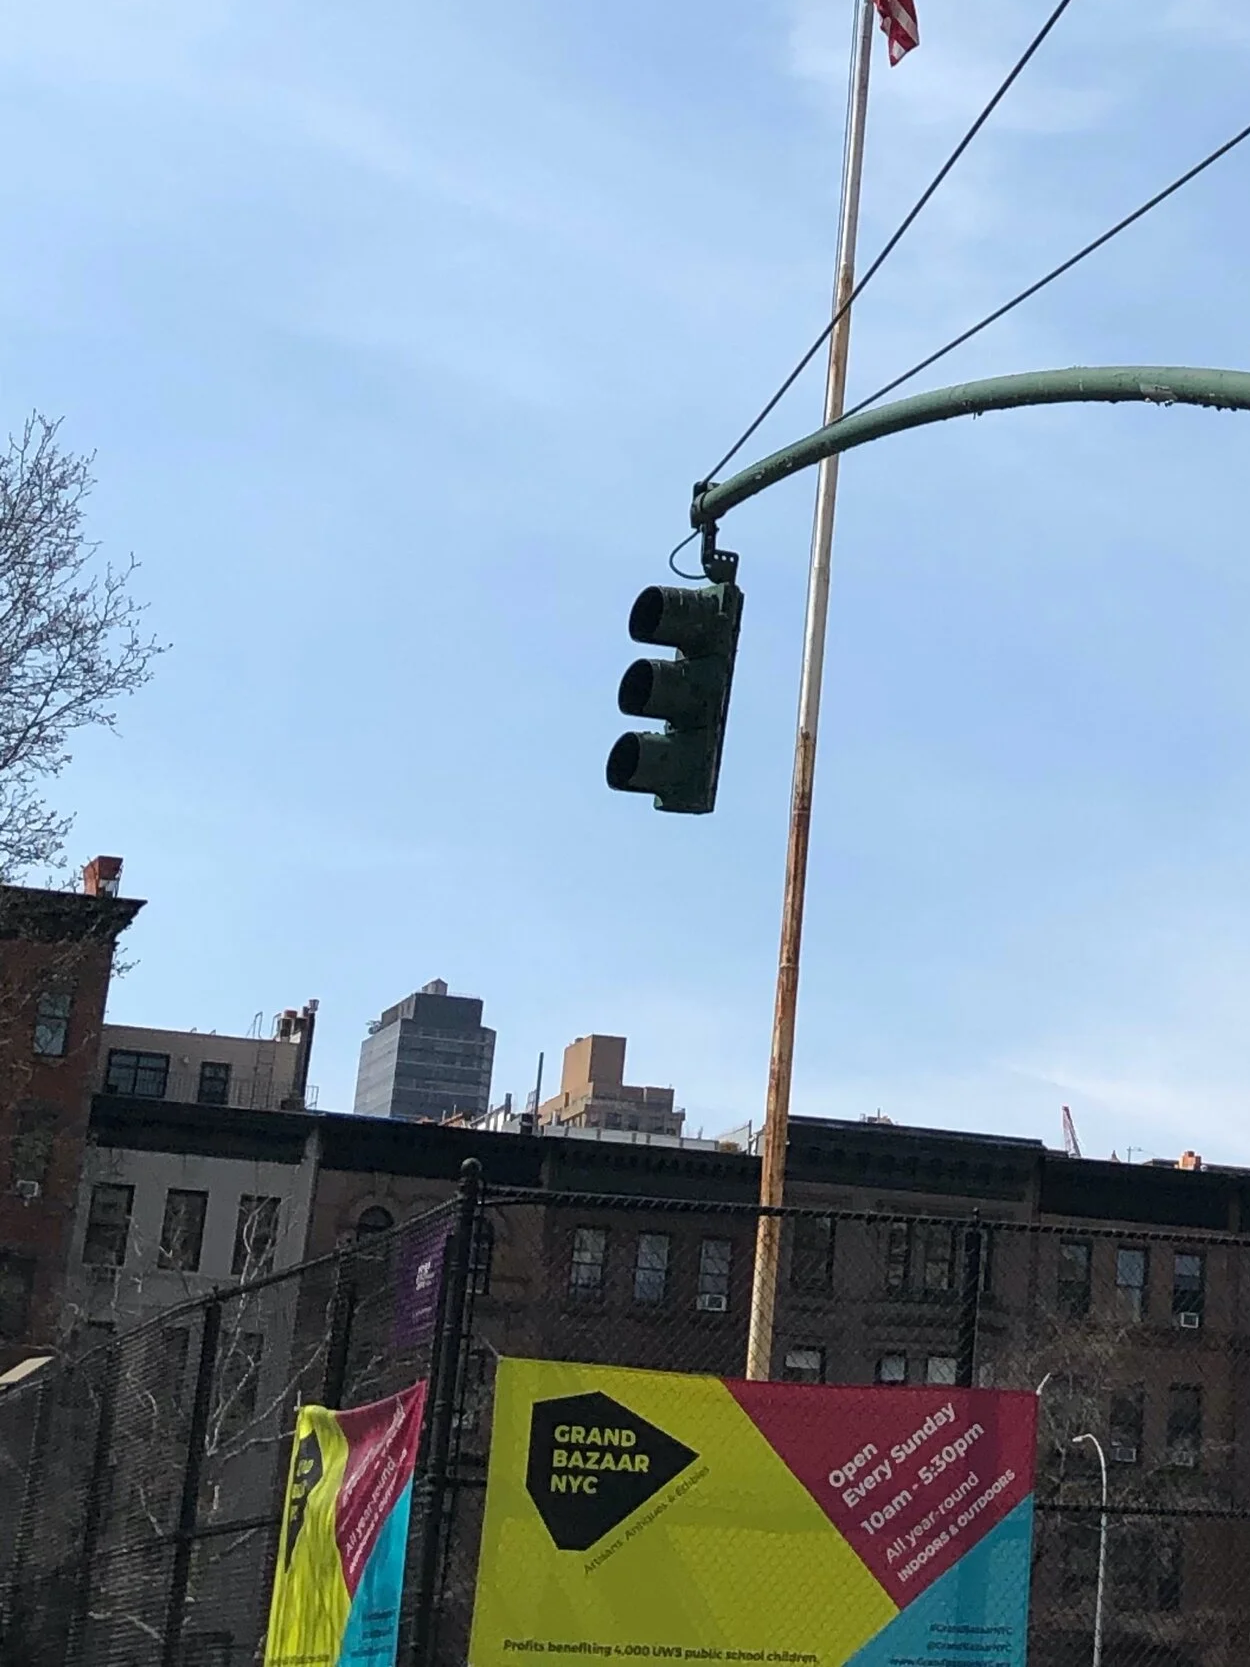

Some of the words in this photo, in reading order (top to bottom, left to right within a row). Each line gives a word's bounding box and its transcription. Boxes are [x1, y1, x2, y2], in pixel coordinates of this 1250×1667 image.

[554, 1424, 637, 1448] GRAND
[842, 1458, 893, 1509] Every
[890, 1402, 957, 1464] Sunday
[552, 1448, 651, 1474] BAZAAR
[828, 1443, 879, 1489] Open
[860, 1489, 914, 1536] 10am
[918, 1423, 986, 1485] 5:30pm
[550, 1473, 599, 1496] NYC
[886, 1536, 907, 1565] All
[905, 1471, 981, 1548] year-round
[897, 1531, 951, 1583] INDOORS
[956, 1468, 1016, 1528] OUTDOORS
[503, 1639, 546, 1653] Profits
[547, 1642, 613, 1657] benefiting
[652, 1646, 683, 1659] UWS
[684, 1647, 722, 1661] public
[725, 1650, 764, 1662] school
